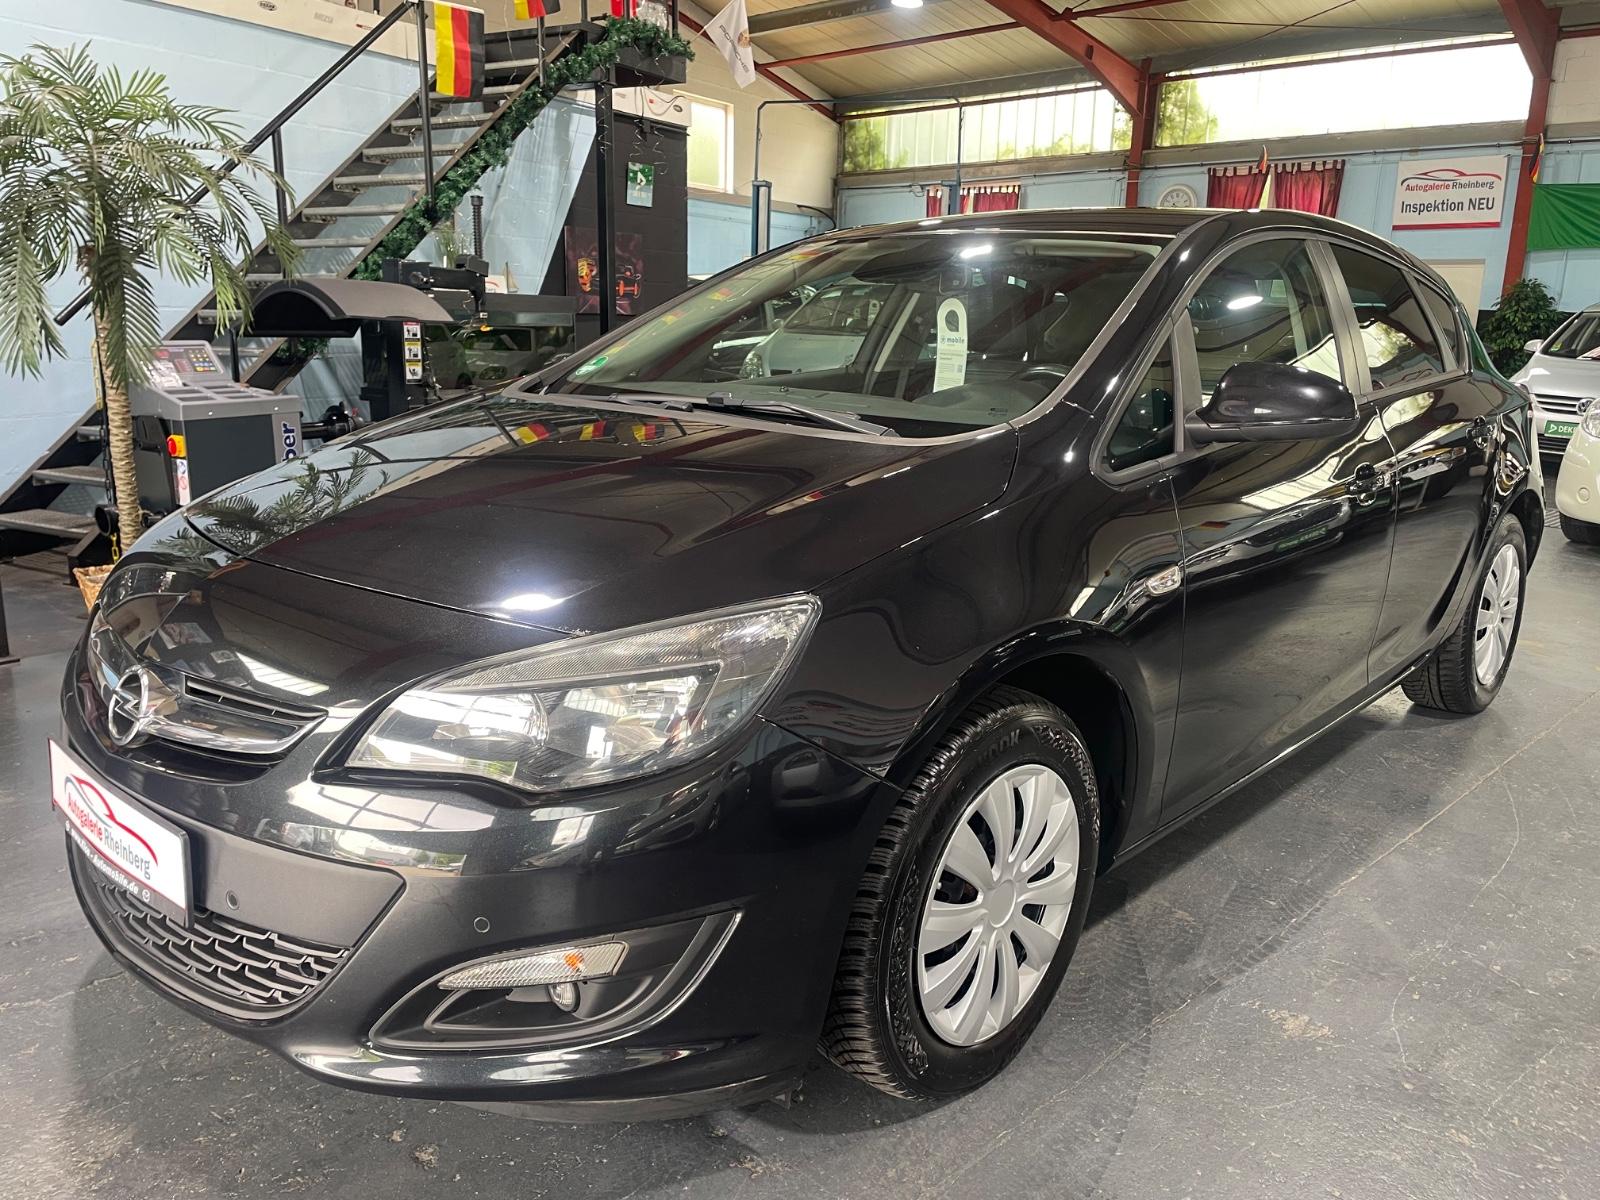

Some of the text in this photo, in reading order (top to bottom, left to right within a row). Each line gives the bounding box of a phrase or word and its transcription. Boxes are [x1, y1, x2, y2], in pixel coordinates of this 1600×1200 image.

[1404, 180, 1495, 193] Autogalerie Rheinberg
[1400, 197, 1496, 216] Inspektion NEU
[1558, 425, 1577, 434] DEK
[68, 791, 151, 880] Autogalerie Rheinberg
